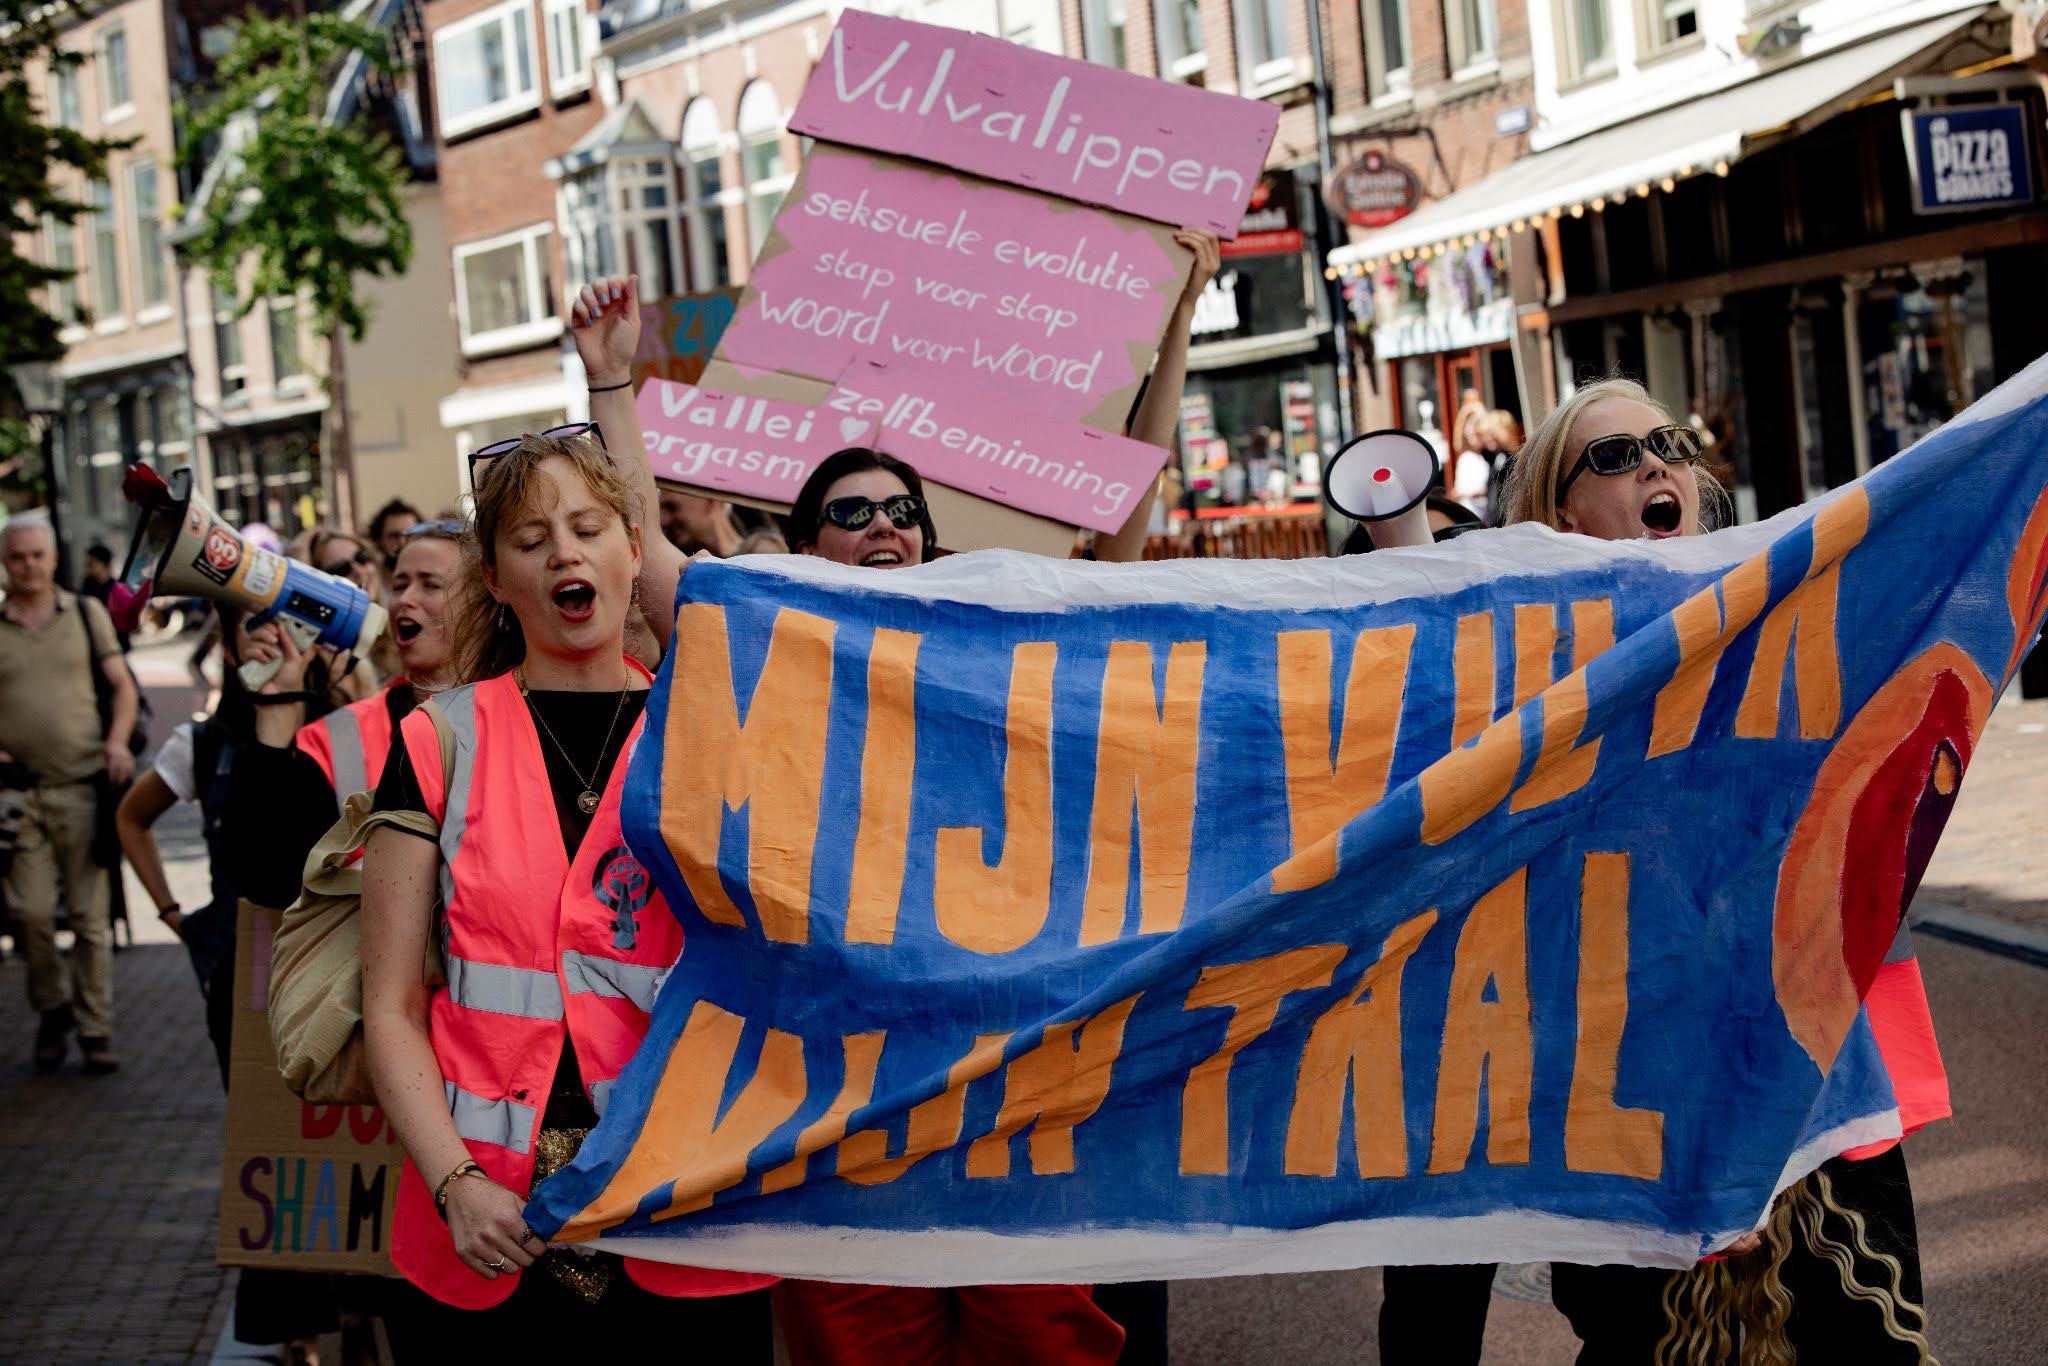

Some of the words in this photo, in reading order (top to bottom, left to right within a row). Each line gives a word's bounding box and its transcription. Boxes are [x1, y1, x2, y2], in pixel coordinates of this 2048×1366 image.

[832, 28, 1244, 203] Vulvalippen
[804, 189, 983, 254] seksuele
[994, 236, 1150, 298] evolutie
[814, 248, 895, 299] stap
[915, 276, 987, 310] voor
[996, 292, 1078, 337] stap
[891, 334, 964, 363] voor
[641, 429, 816, 482] orgasm
[660, 382, 816, 444] Vallei
[829, 386, 1132, 517] zelfbeminning
[659, 602, 1207, 955] MIJN
[1178, 852, 1664, 1182] TAAL
